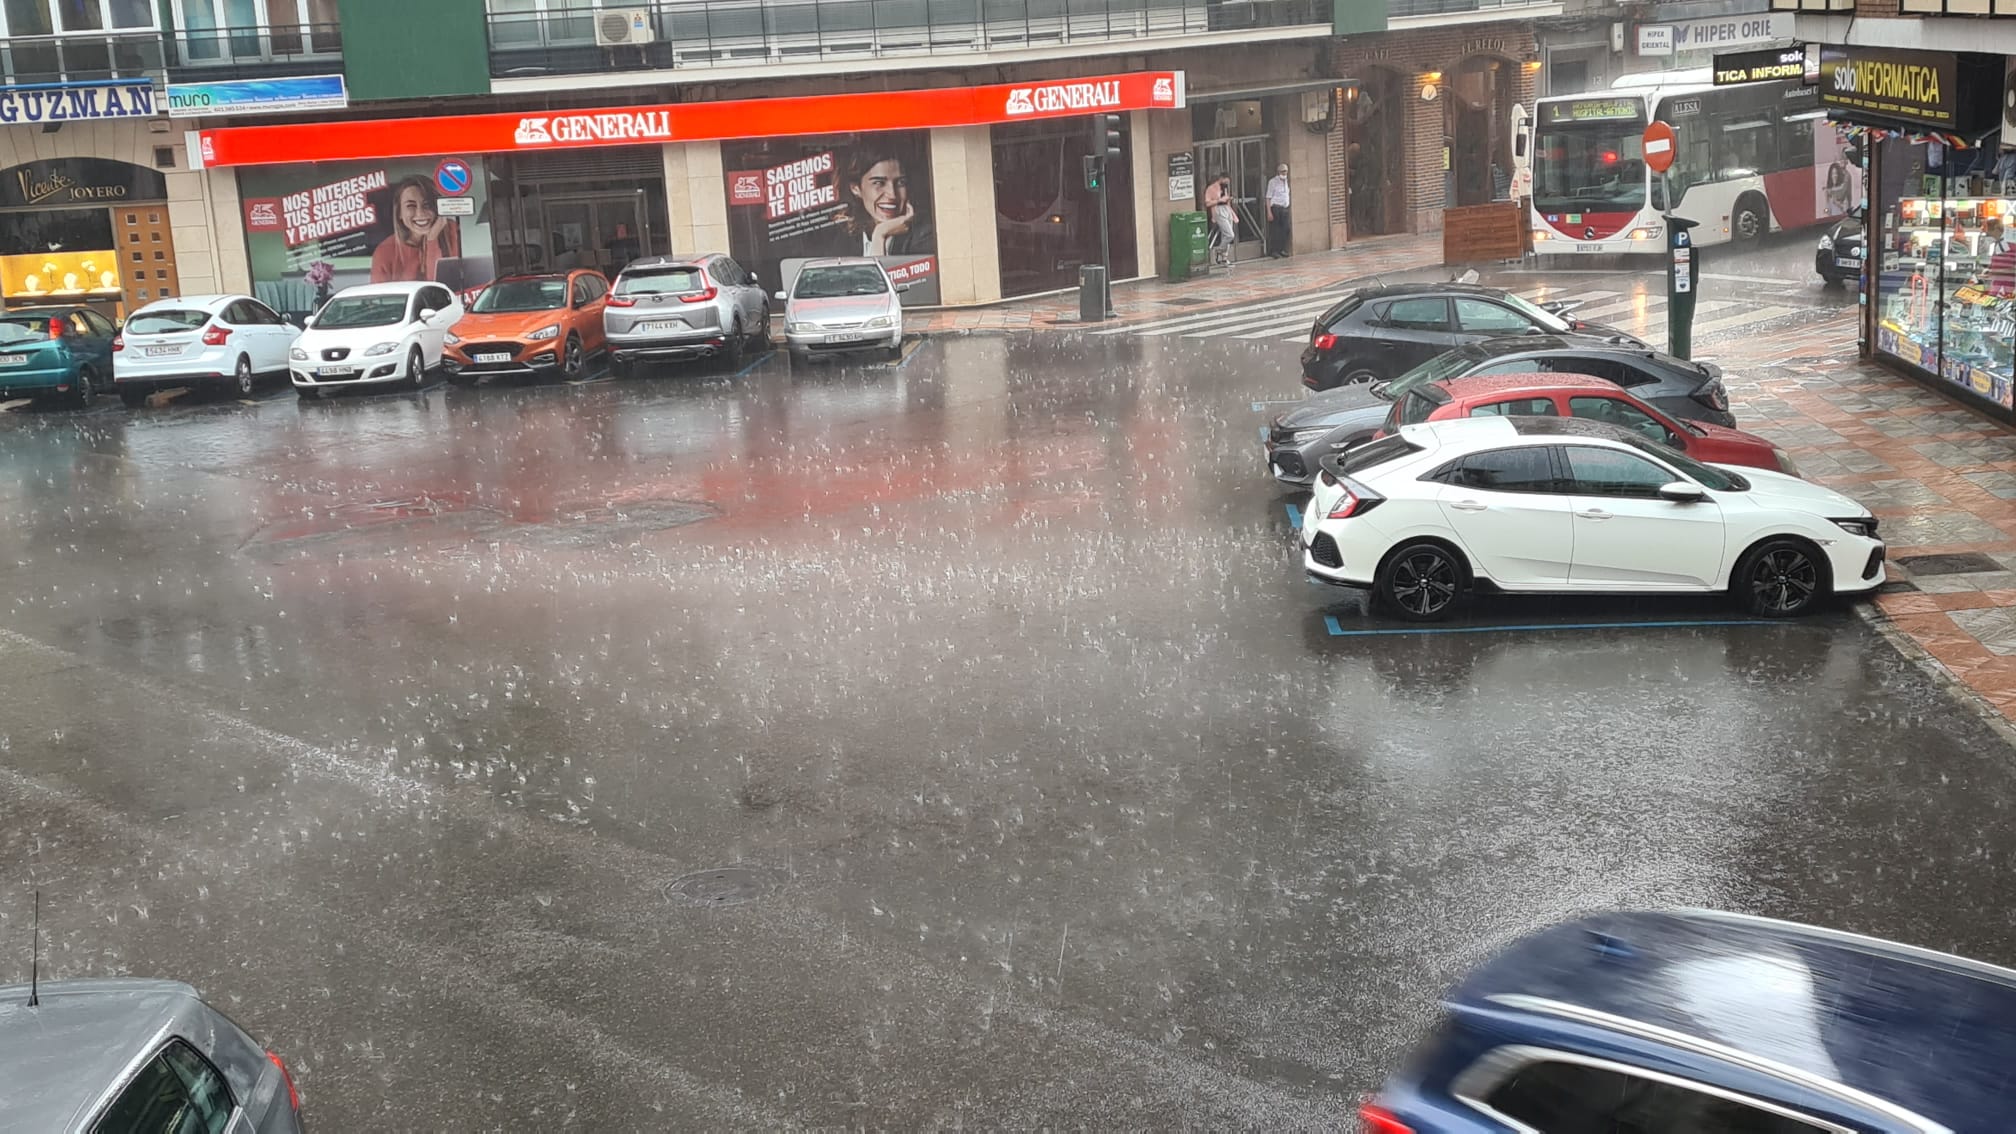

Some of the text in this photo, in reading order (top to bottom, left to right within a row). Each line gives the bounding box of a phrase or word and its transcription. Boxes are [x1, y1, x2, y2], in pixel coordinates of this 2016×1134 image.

[1647, 30, 1665, 39] HIPER
[1694, 23, 1737, 44] HIPER
[1641, 41, 1670, 50] ORIENTAL
[0, 86, 152, 122] GUZMAN
[168, 93, 210, 108] muro
[1033, 79, 1121, 111] GENERALI
[1552, 105, 1560, 117] 1
[1674, 101, 1699, 113] ALESA
[550, 111, 671, 143] GENERALI
[766, 153, 832, 185] SABEMOS
[17, 168, 69, 202] Vicente
[69, 185, 126, 200] JOYERO
[282, 170, 386, 213] NOS INTERESAN
[768, 175, 814, 201] LO QUE
[768, 185, 835, 217] TE MUEVE
[284, 208, 311, 229] TUS
[286, 206, 376, 244] Y PROYECTOS
[1679, 231, 1688, 246] P
[909, 261, 930, 275] TODO
